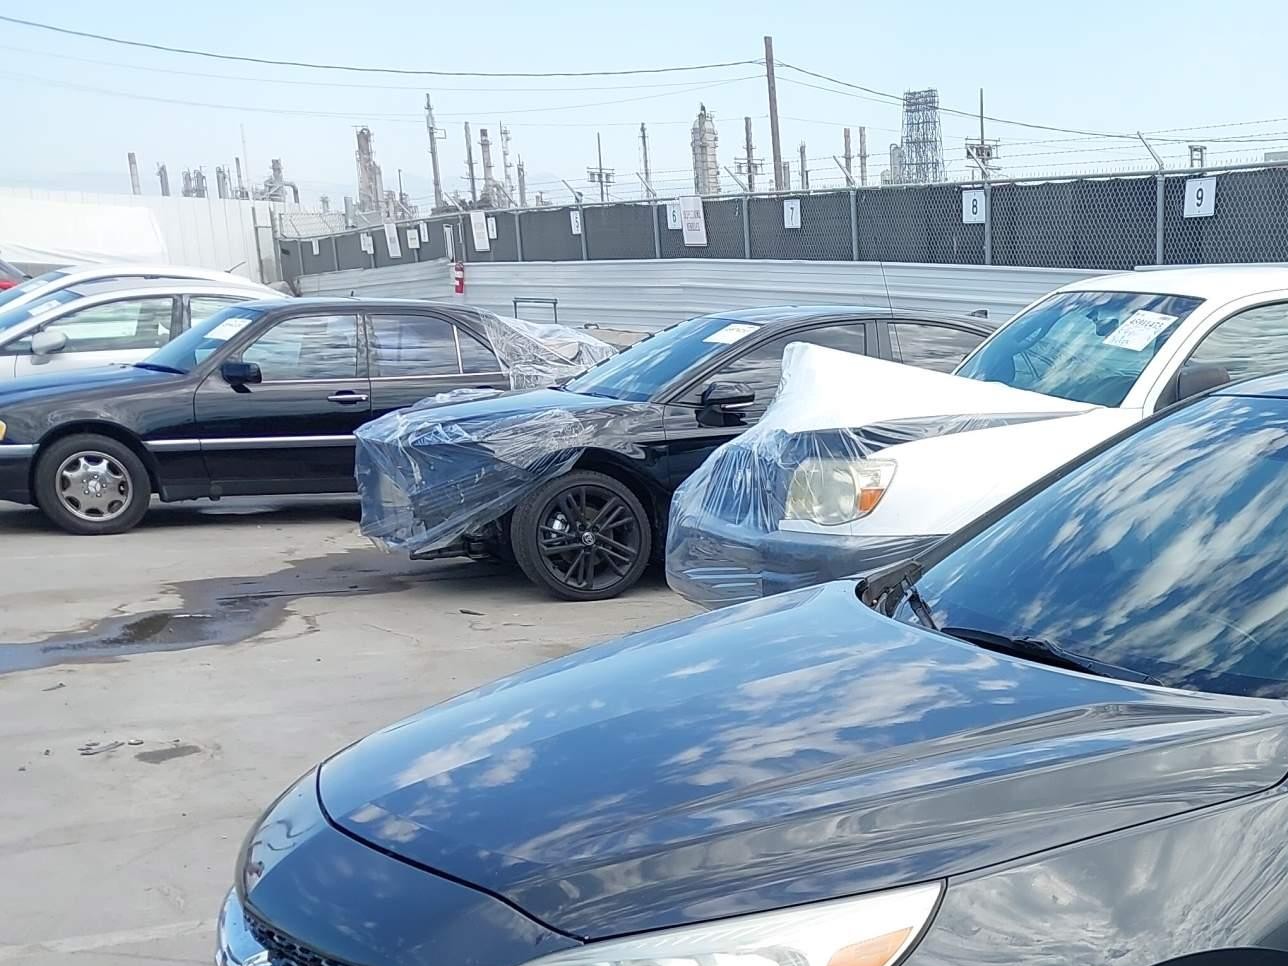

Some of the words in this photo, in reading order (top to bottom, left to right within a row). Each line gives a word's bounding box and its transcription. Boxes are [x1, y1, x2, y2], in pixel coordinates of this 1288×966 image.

[1195, 187, 1204, 207] 9
[671, 209, 677, 223] 6
[789, 206, 796, 225] 7
[971, 198, 978, 216] 8
